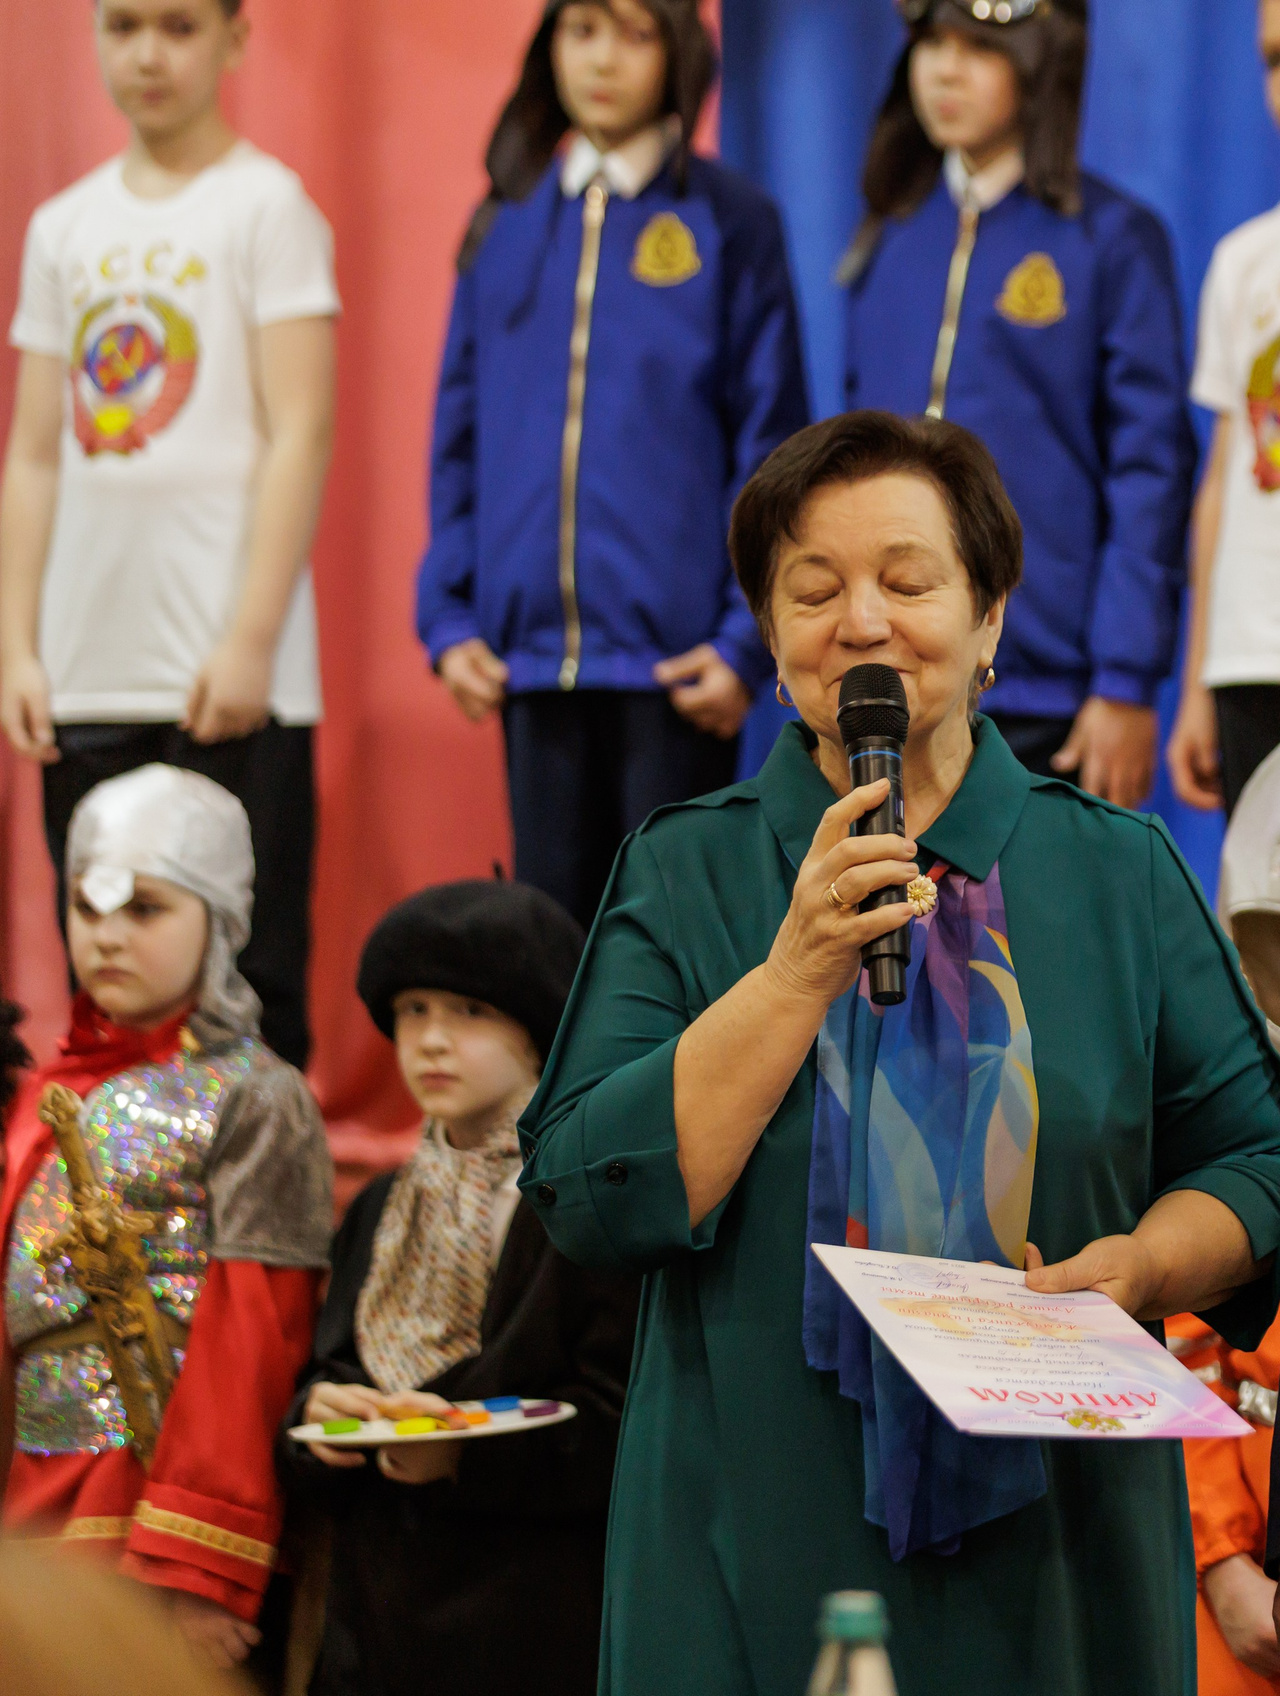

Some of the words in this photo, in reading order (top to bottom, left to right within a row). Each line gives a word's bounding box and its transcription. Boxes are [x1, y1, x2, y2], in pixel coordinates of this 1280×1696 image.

[880, 1286, 926, 1297] темы
[931, 1294, 1014, 1308] раскрытие
[951, 1306, 1005, 1316] номинация
[1020, 1304, 1074, 1314] Лучшее
[897, 1308, 974, 1322] Гимназии
[978, 1318, 1076, 1330] Жемчужинка
[971, 1326, 1020, 1334] конкурсе
[934, 1335, 1017, 1346] традиционном
[1030, 1342, 1065, 1350] победу
[958, 1353, 1040, 1365] руководитель
[1046, 1359, 1104, 1367] Классный
[994, 1377, 1103, 1389] Награждается
[966, 1387, 1157, 1407] ДИПЛОМ
